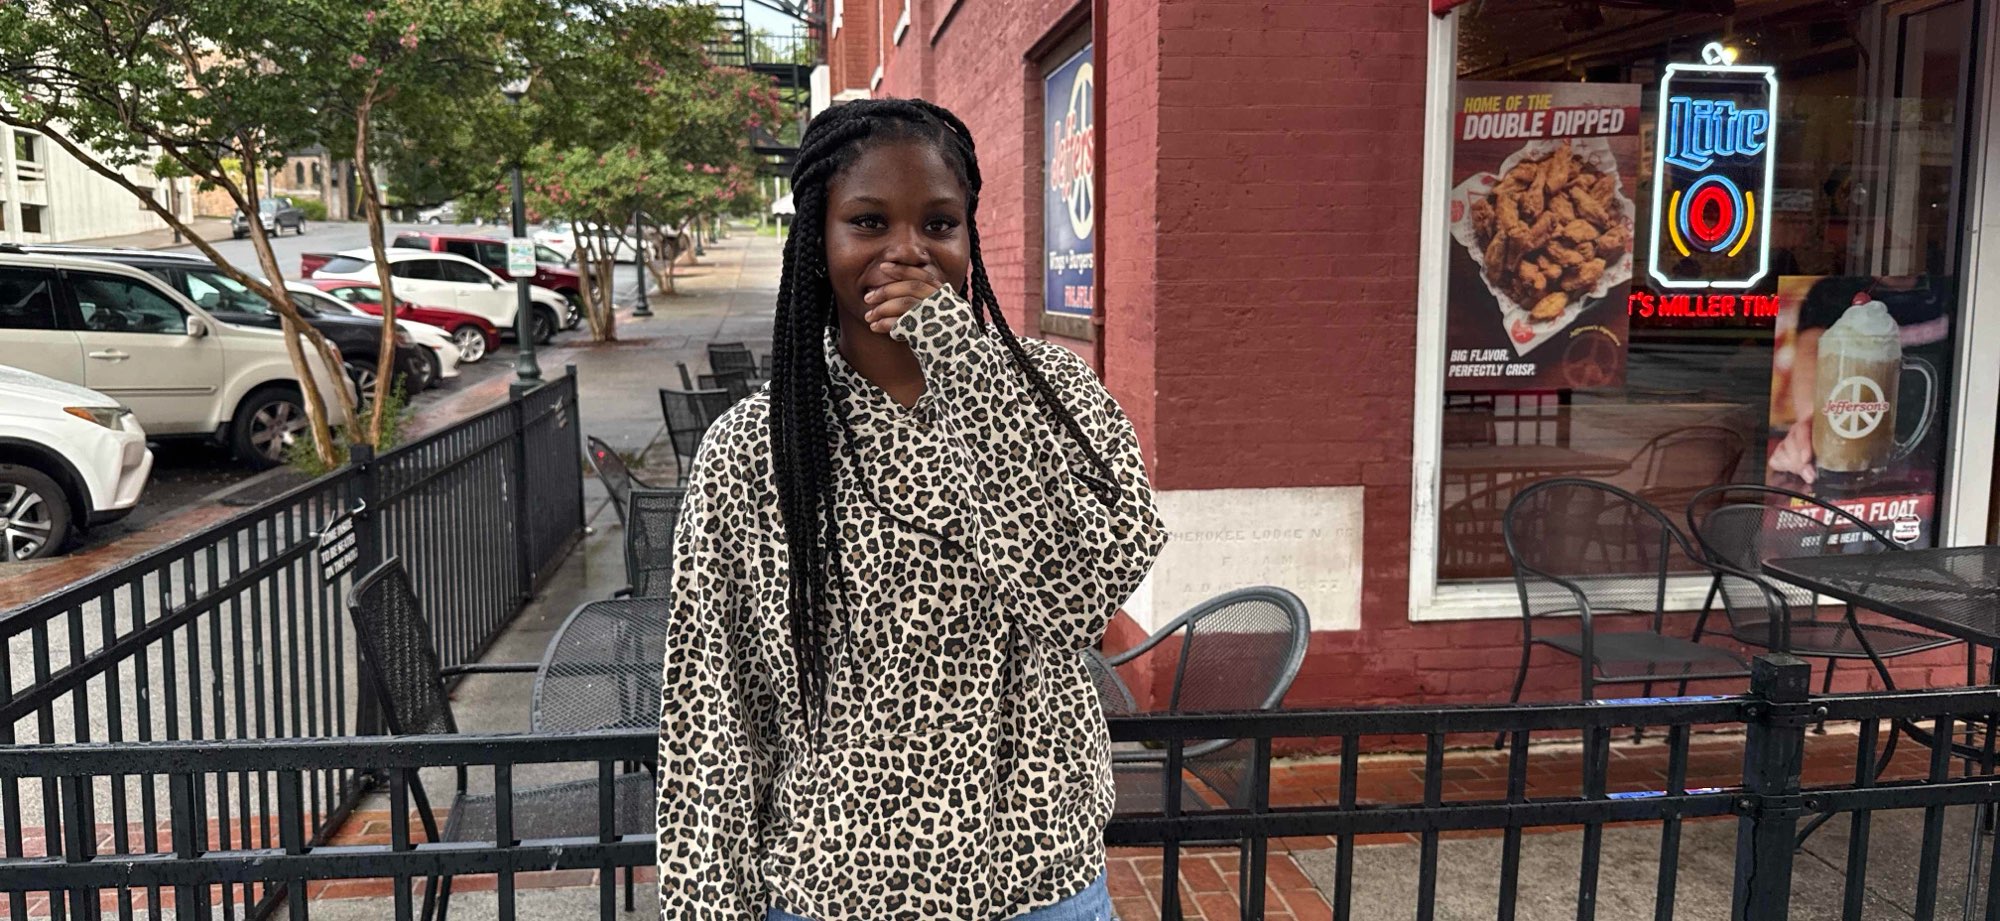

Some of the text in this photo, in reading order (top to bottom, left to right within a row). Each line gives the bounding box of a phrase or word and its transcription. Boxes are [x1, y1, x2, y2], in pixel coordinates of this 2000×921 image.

[1464, 94, 1553, 113] HOME OF THE
[1463, 108, 1625, 140] DOUBLE DIPPED
[1665, 96, 1768, 171] Lite
[1051, 110, 1094, 202] Jeffers
[1658, 295, 1735, 317] MILLER
[1741, 295, 1779, 317] TIM
[1450, 349, 1509, 362] BIG FLAVOR.
[1448, 363, 1536, 377] PERFECTLY CRISP.
[1869, 500, 1920, 520] FLOAT
[1252, 527, 1303, 540] LODGE
